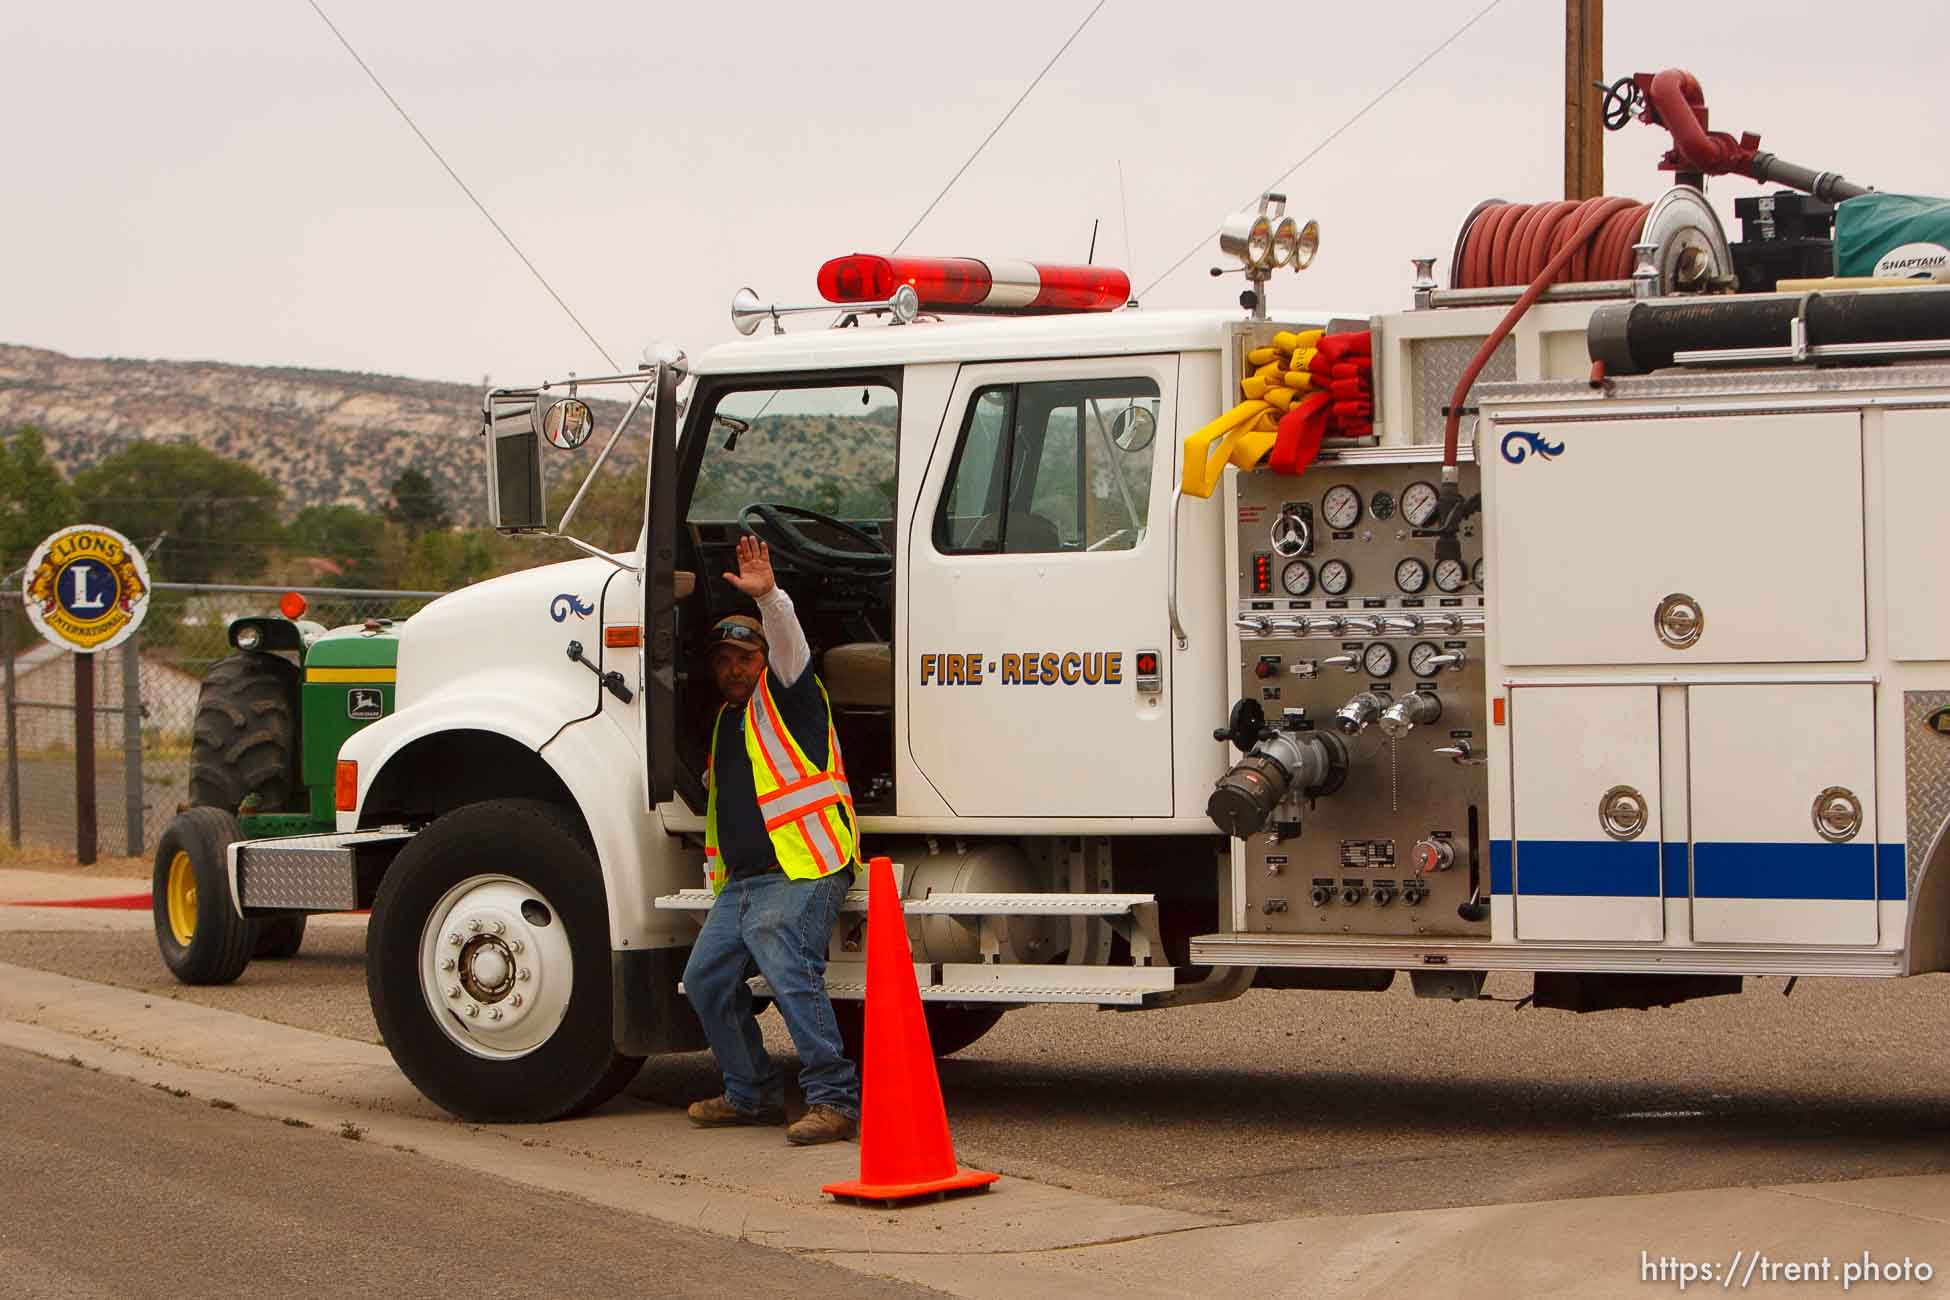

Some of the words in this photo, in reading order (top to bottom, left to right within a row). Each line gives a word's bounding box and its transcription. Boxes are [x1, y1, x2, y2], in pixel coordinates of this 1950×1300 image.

[1881, 255, 1946, 270] SNAPTANK
[57, 535, 118, 557] LIONS
[70, 565, 105, 609] L
[920, 653, 984, 687] FIRE
[1001, 651, 1124, 686] RESCUE
